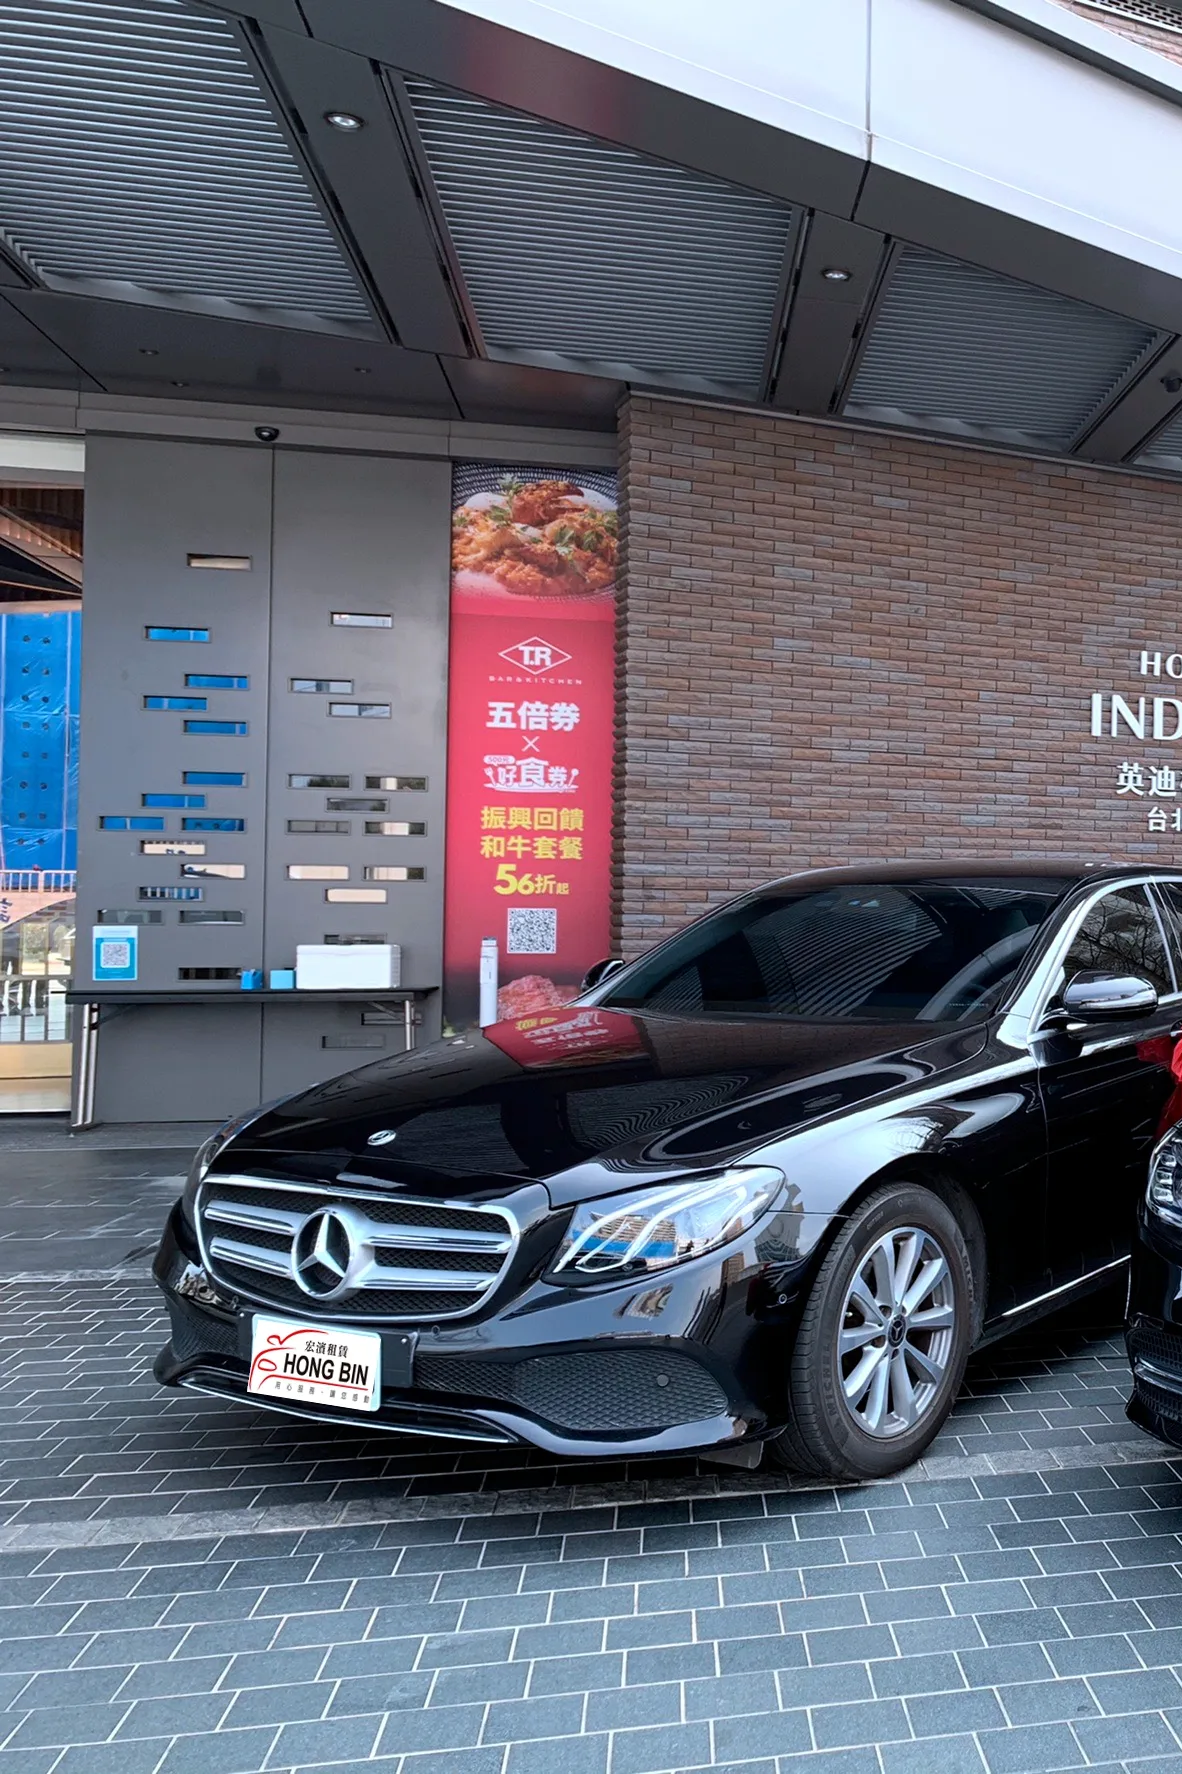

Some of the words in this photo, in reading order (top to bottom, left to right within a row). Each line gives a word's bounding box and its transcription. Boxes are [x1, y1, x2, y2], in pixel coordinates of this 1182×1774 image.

[485, 700, 580, 732] 五倍券
[480, 805, 585, 832] 振興回饋
[480, 834, 584, 860] 和牛套餐
[493, 863, 570, 896] 56折起
[283, 1352, 335, 1380] HONG
[338, 1361, 370, 1386] BIN
